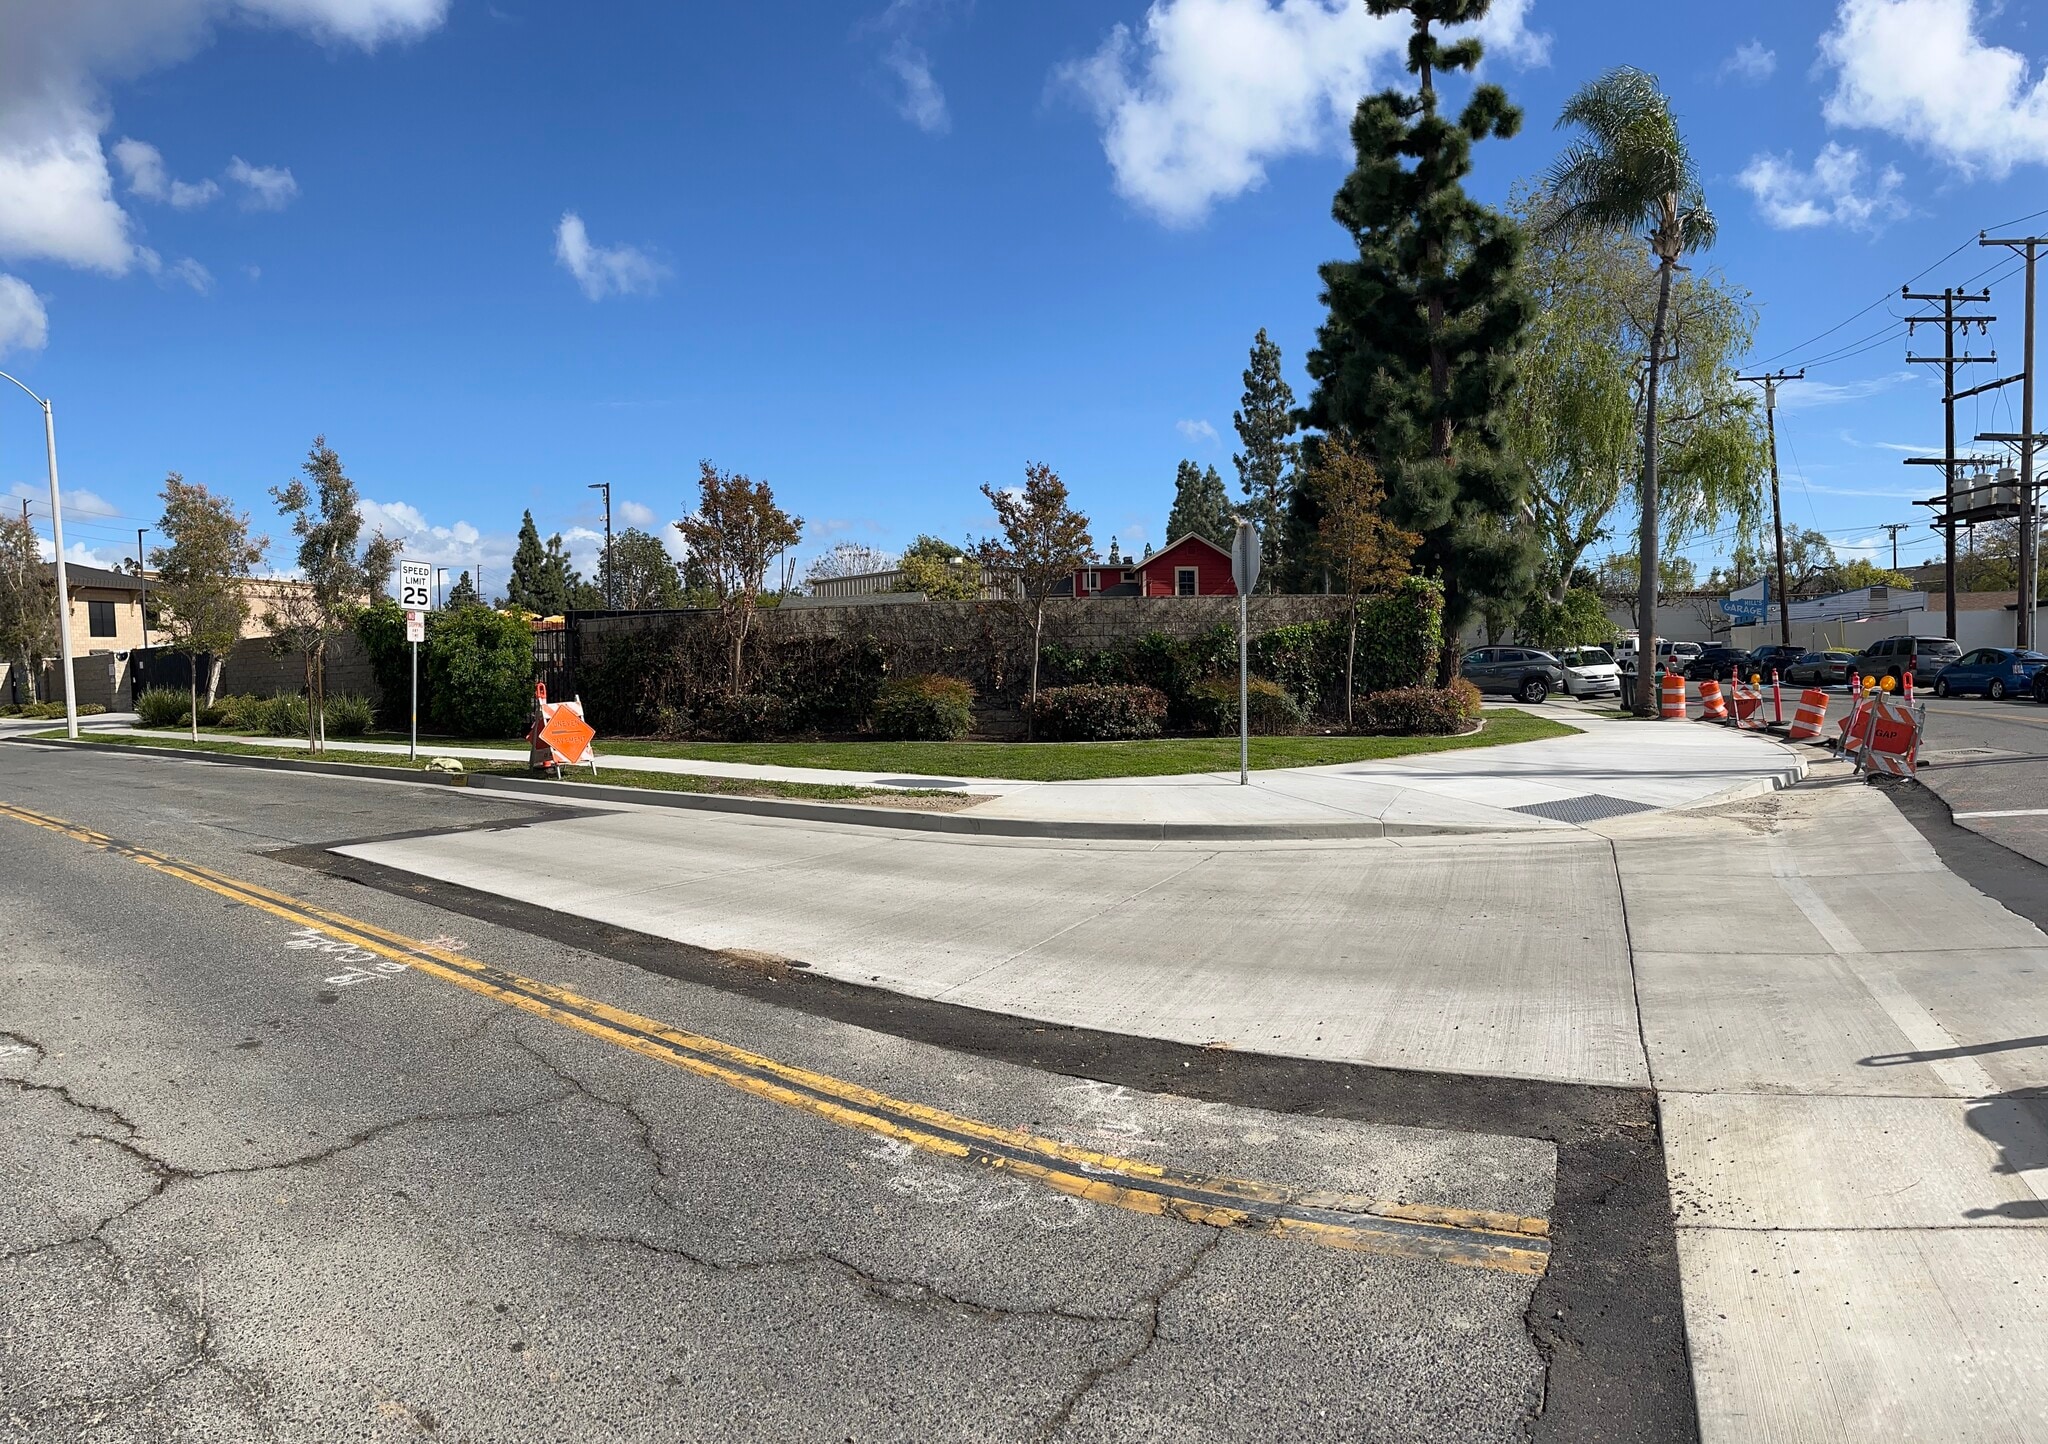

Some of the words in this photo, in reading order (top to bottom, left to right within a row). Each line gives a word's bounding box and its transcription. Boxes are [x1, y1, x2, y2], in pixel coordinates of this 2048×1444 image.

[402, 566, 429, 576] SPEED
[405, 577, 426, 585] LIMIT
[403, 586, 428, 605] 25
[1723, 602, 1762, 615] GARAGE
[553, 720, 580, 728] UNEVEN
[1875, 729, 1897, 739] GAP
[552, 736, 587, 744] PAVEMENT
